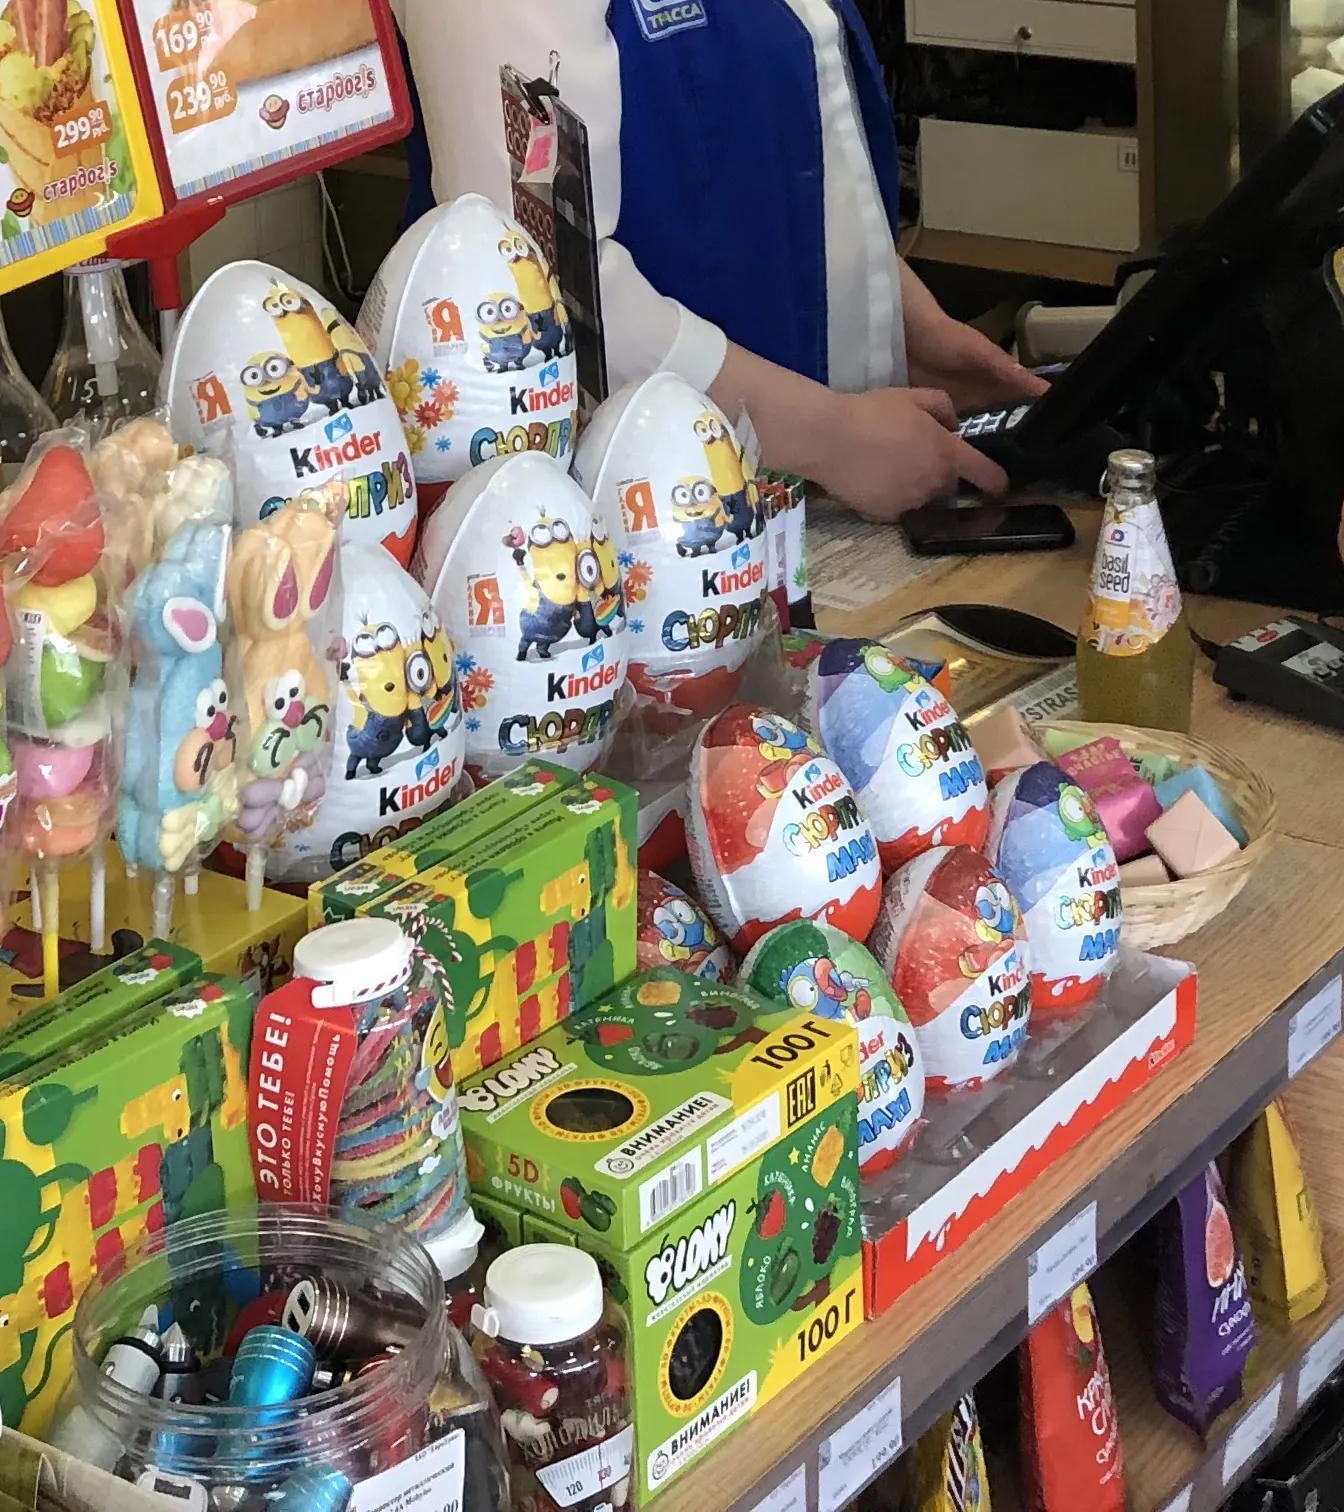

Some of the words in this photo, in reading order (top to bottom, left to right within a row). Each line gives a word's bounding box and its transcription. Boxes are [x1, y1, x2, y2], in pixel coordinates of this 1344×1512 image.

[510, 378, 575, 416] Kinder
[291, 428, 382, 479] Kinder
[702, 559, 765, 598] Kinder
[547, 660, 621, 703] Kinder
[379, 756, 458, 817] Kinder
[792, 769, 845, 809] Kinder
[257, 1012, 293, 1111] ТЕБЕ!
[620, 1094, 714, 1158] ВНИМАНИЕ!
[801, 1120, 827, 1173] АНАНАС
[256, 1121, 280, 1190] ЭТО
[507, 1153, 540, 1183] 5D
[491, 1175, 556, 1214] ФРУКТЫ
[754, 1255, 773, 1310] ЯБЛОКО
[670, 1378, 752, 1456] ВНИМАНИЕ!
